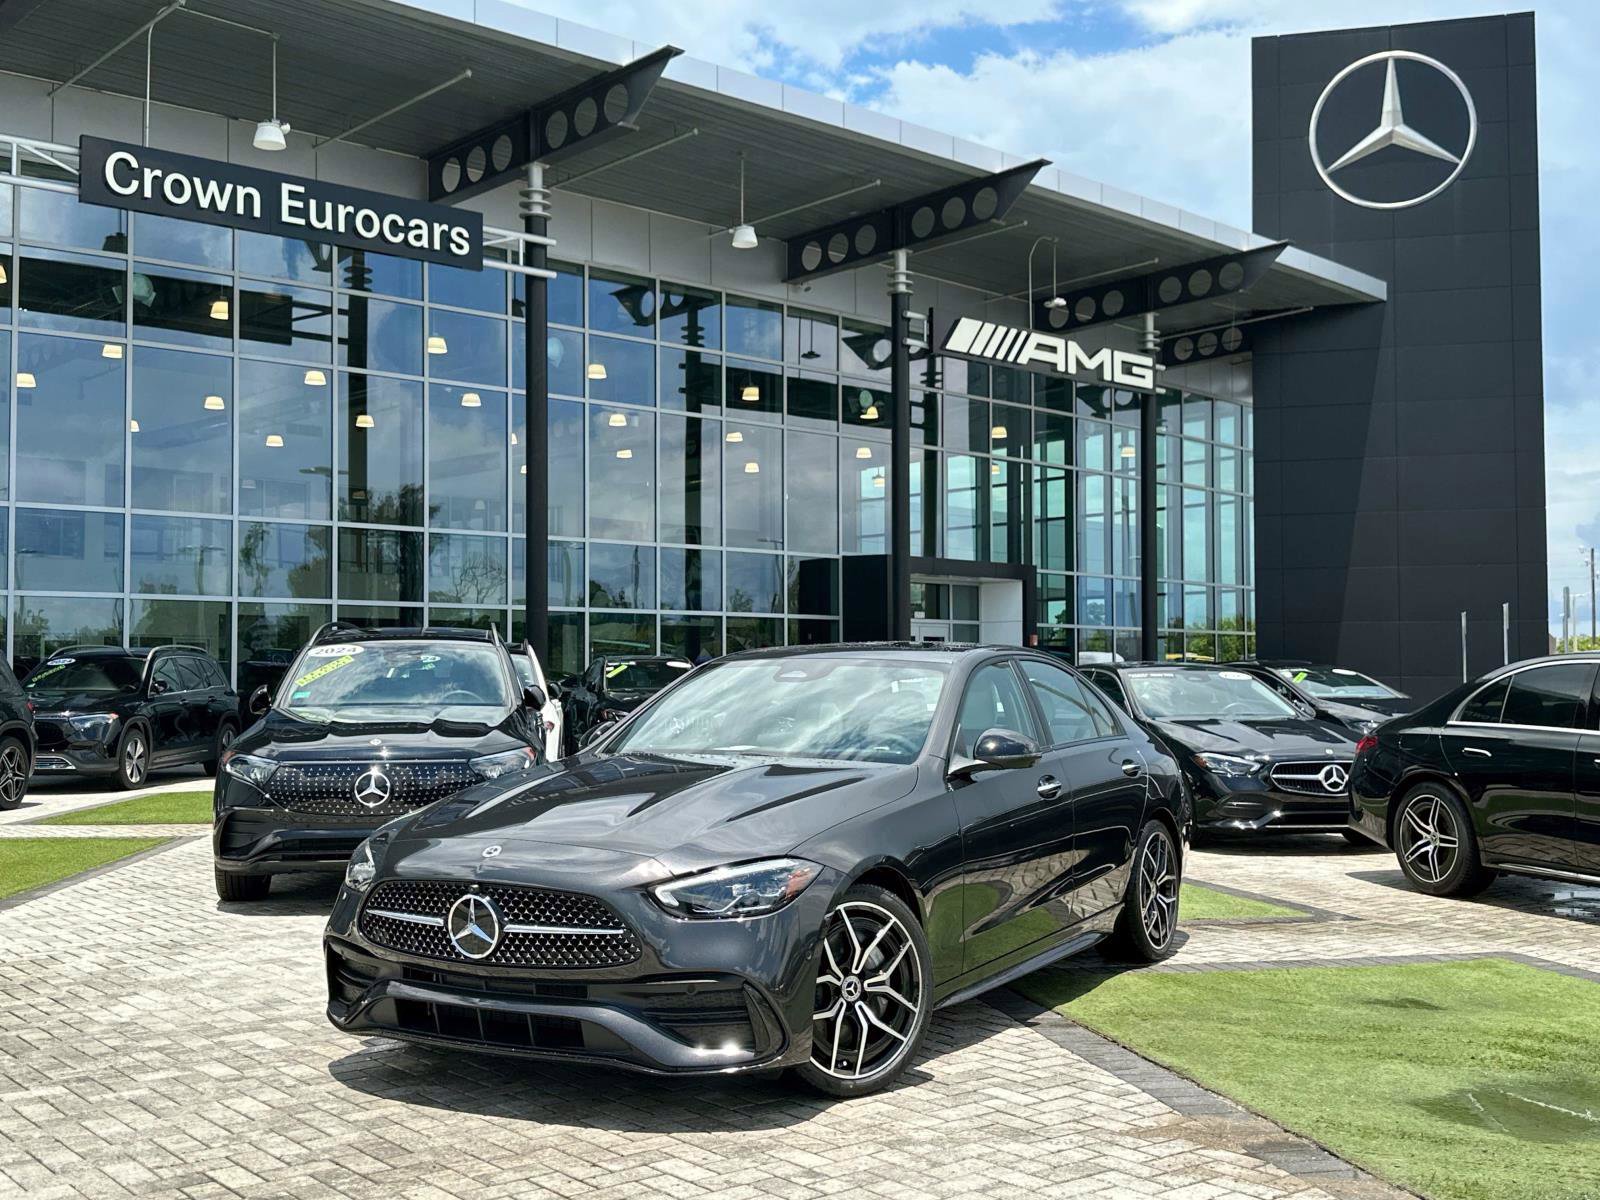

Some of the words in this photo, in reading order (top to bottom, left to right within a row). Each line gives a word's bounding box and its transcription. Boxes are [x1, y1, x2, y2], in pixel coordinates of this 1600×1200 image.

[104, 151, 262, 219] Crown
[280, 182, 471, 257] Eurocars
[1016, 331, 1154, 390] AMG
[313, 646, 358, 656] 2024
